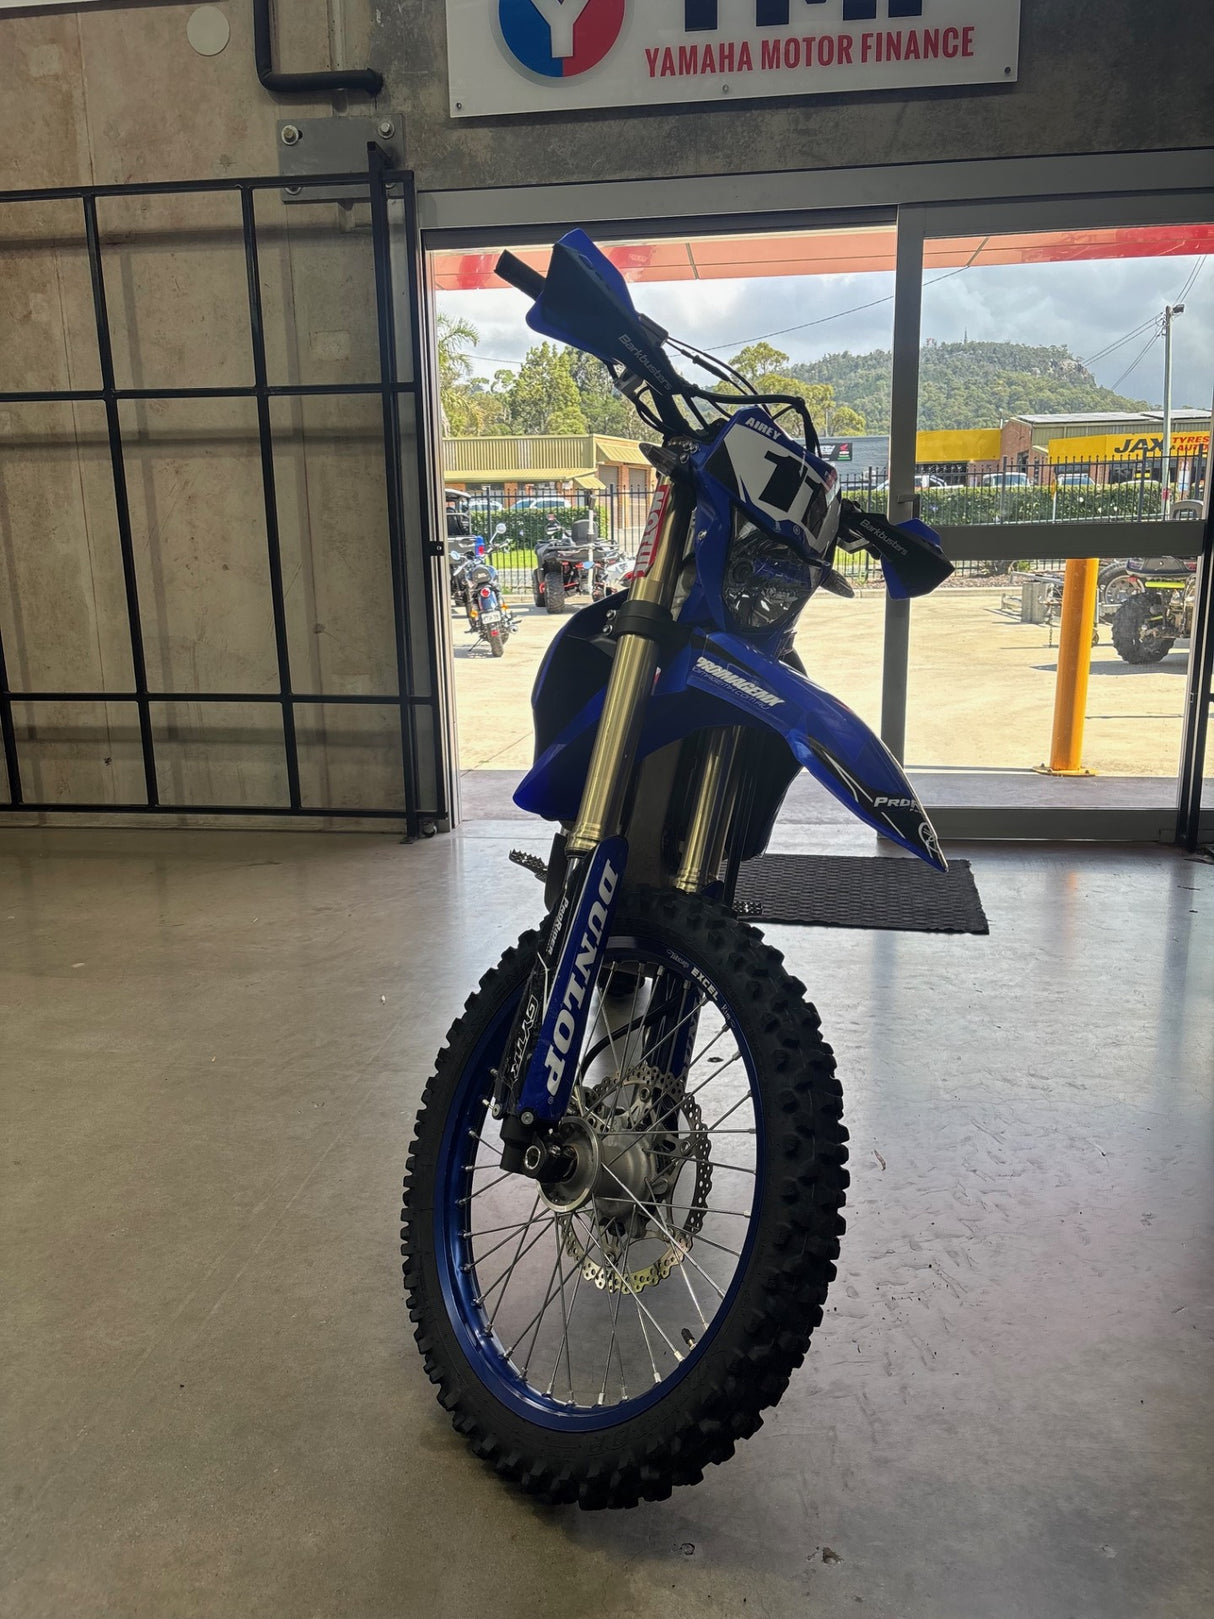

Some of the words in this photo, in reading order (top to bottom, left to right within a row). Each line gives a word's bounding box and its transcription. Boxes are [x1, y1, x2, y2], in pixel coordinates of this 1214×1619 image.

[645, 41, 753, 78] YAMAHA
[761, 34, 853, 70] MOTOR
[861, 26, 975, 63] FINANCE
[618, 334, 672, 391] Barkbusters
[745, 417, 781, 440] AIREY
[1114, 438, 1164, 453] JAX
[1172, 435, 1210, 443] TYRES
[860, 519, 908, 555] Barkbusters
[544, 859, 619, 1098] DUNLOP
[691, 967, 719, 1001] EXCEL
